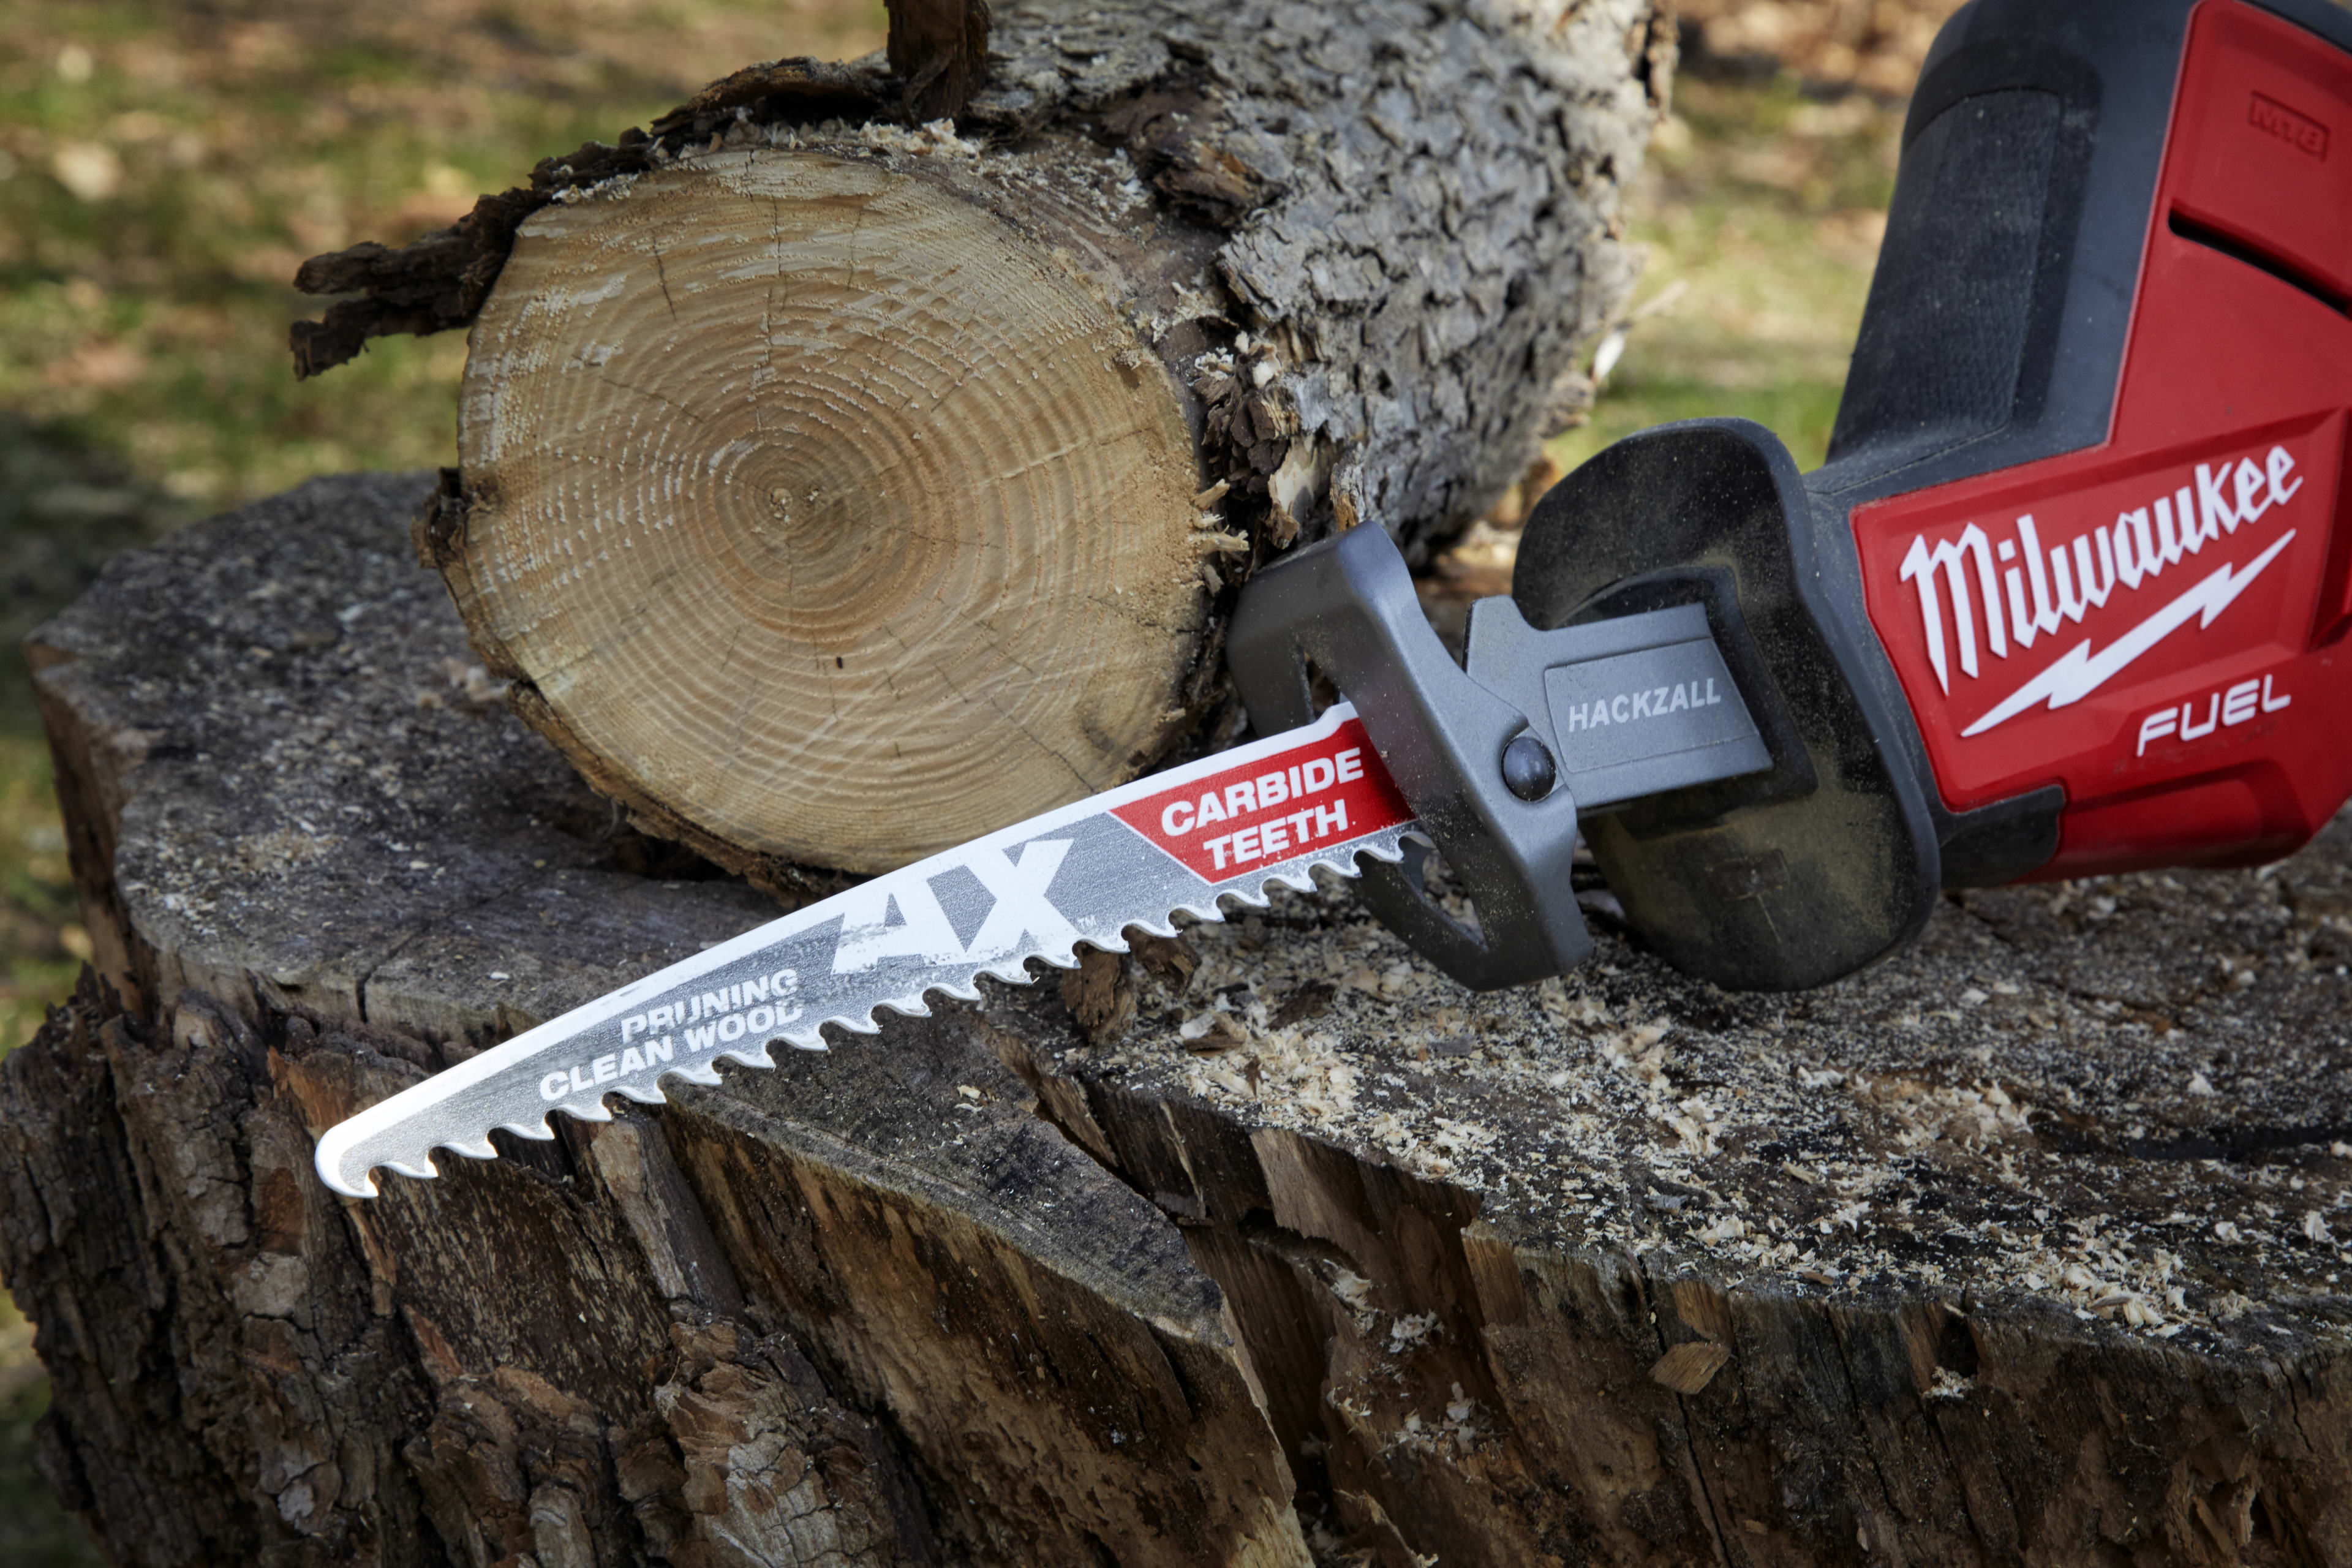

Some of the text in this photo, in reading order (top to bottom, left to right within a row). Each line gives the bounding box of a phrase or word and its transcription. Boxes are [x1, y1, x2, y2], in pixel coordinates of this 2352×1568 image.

[1900, 445, 2303, 696] Milwaukee
[1569, 678, 1721, 732] HACKZALL
[2136, 674, 2291, 757] FUEL
[1161, 747, 1363, 837] CARBIDE
[1202, 799, 1348, 870] TEETH
[831, 838, 1082, 974] AX
[621, 969, 798, 1043] PRUNING
[540, 1001, 803, 1101] CLEAN WOOD
